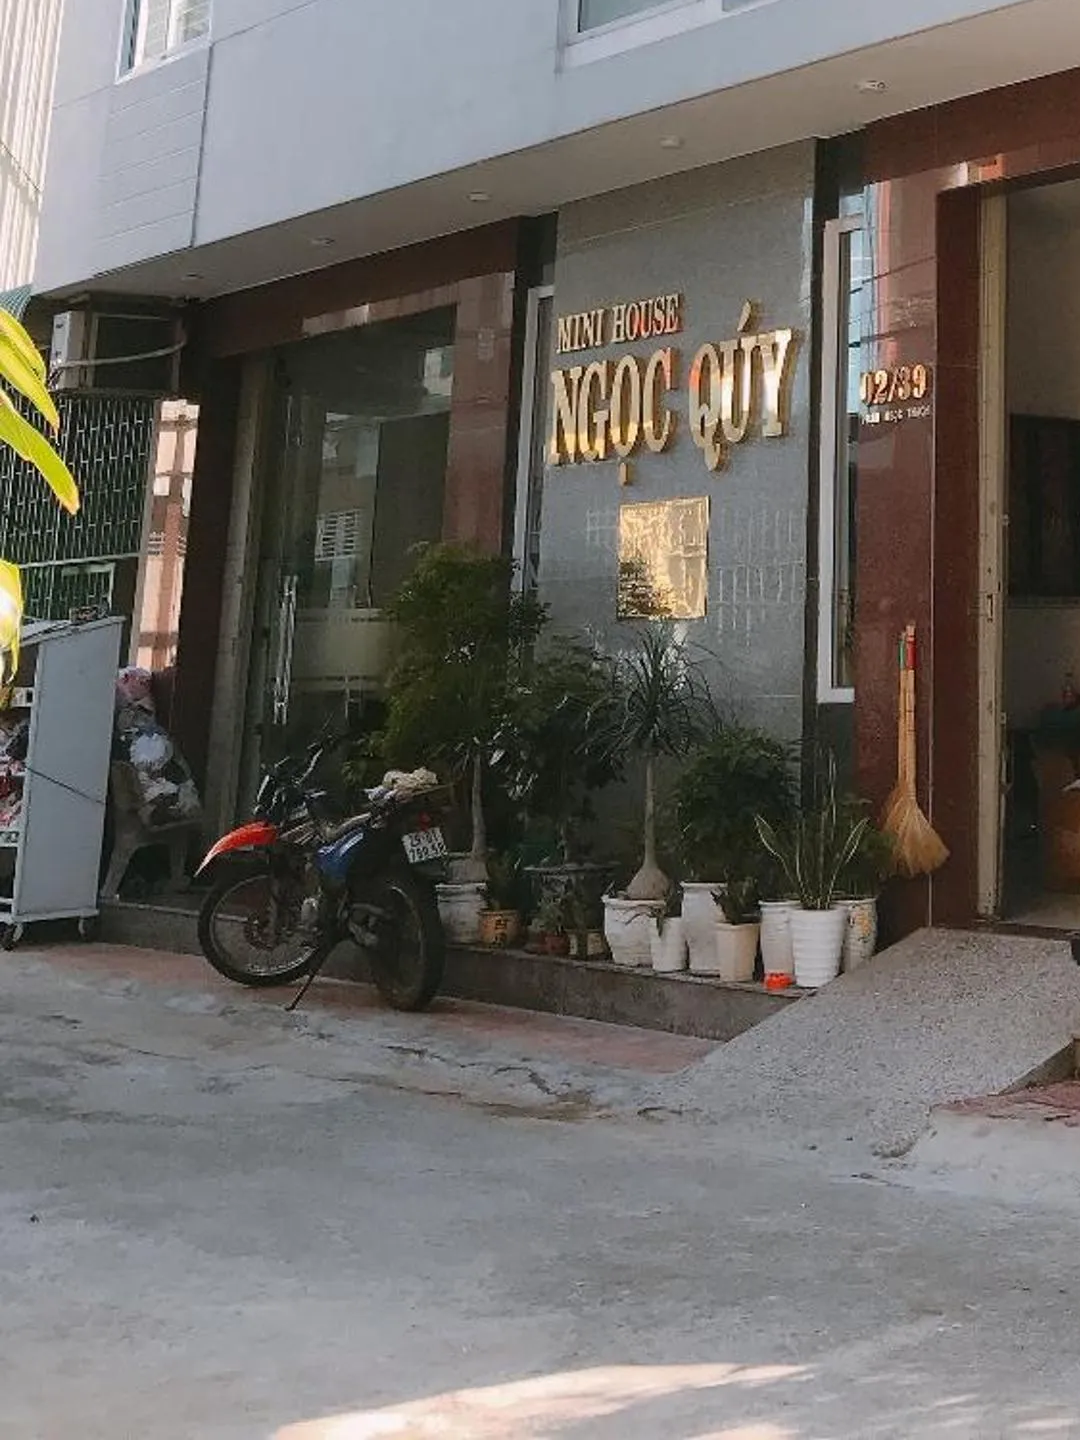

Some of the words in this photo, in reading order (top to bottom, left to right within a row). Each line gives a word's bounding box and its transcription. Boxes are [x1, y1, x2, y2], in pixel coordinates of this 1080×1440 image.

[556, 309, 605, 354] MINI
[611, 293, 681, 344] HOUSE
[859, 363, 928, 406] 02/39
[547, 346, 678, 487] NGỌC
